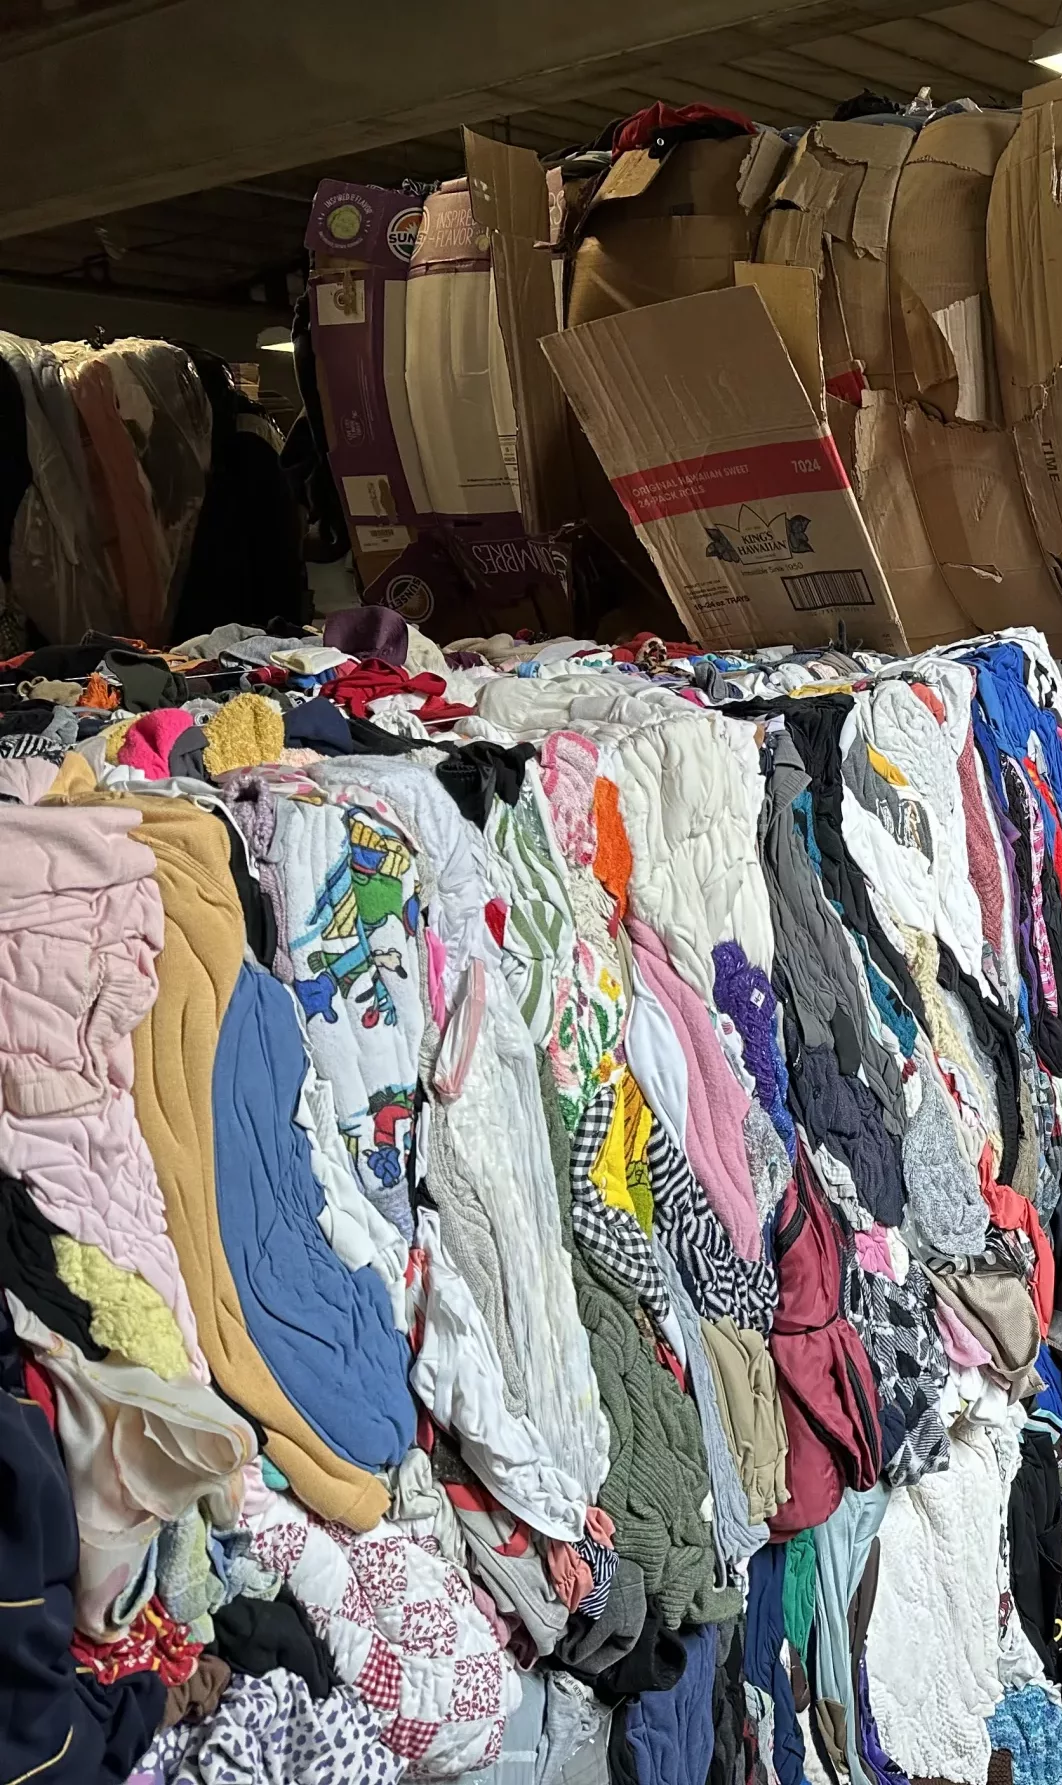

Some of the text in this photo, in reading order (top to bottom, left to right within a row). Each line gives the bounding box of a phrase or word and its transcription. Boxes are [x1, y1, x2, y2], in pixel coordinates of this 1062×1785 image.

[790, 459, 822, 474] 7024
[1041, 438, 1061, 484] TIME
[631, 463, 750, 498] ORIGINAL HAWAIIAN SWEET
[637, 484, 706, 509] 24-PACK ROLLS
[737, 540, 788, 556] HAWAIIAN
[785, 561, 804, 572] 1950
[389, 578, 421, 610] SUNSET
[724, 595, 751, 606] TRAYS
